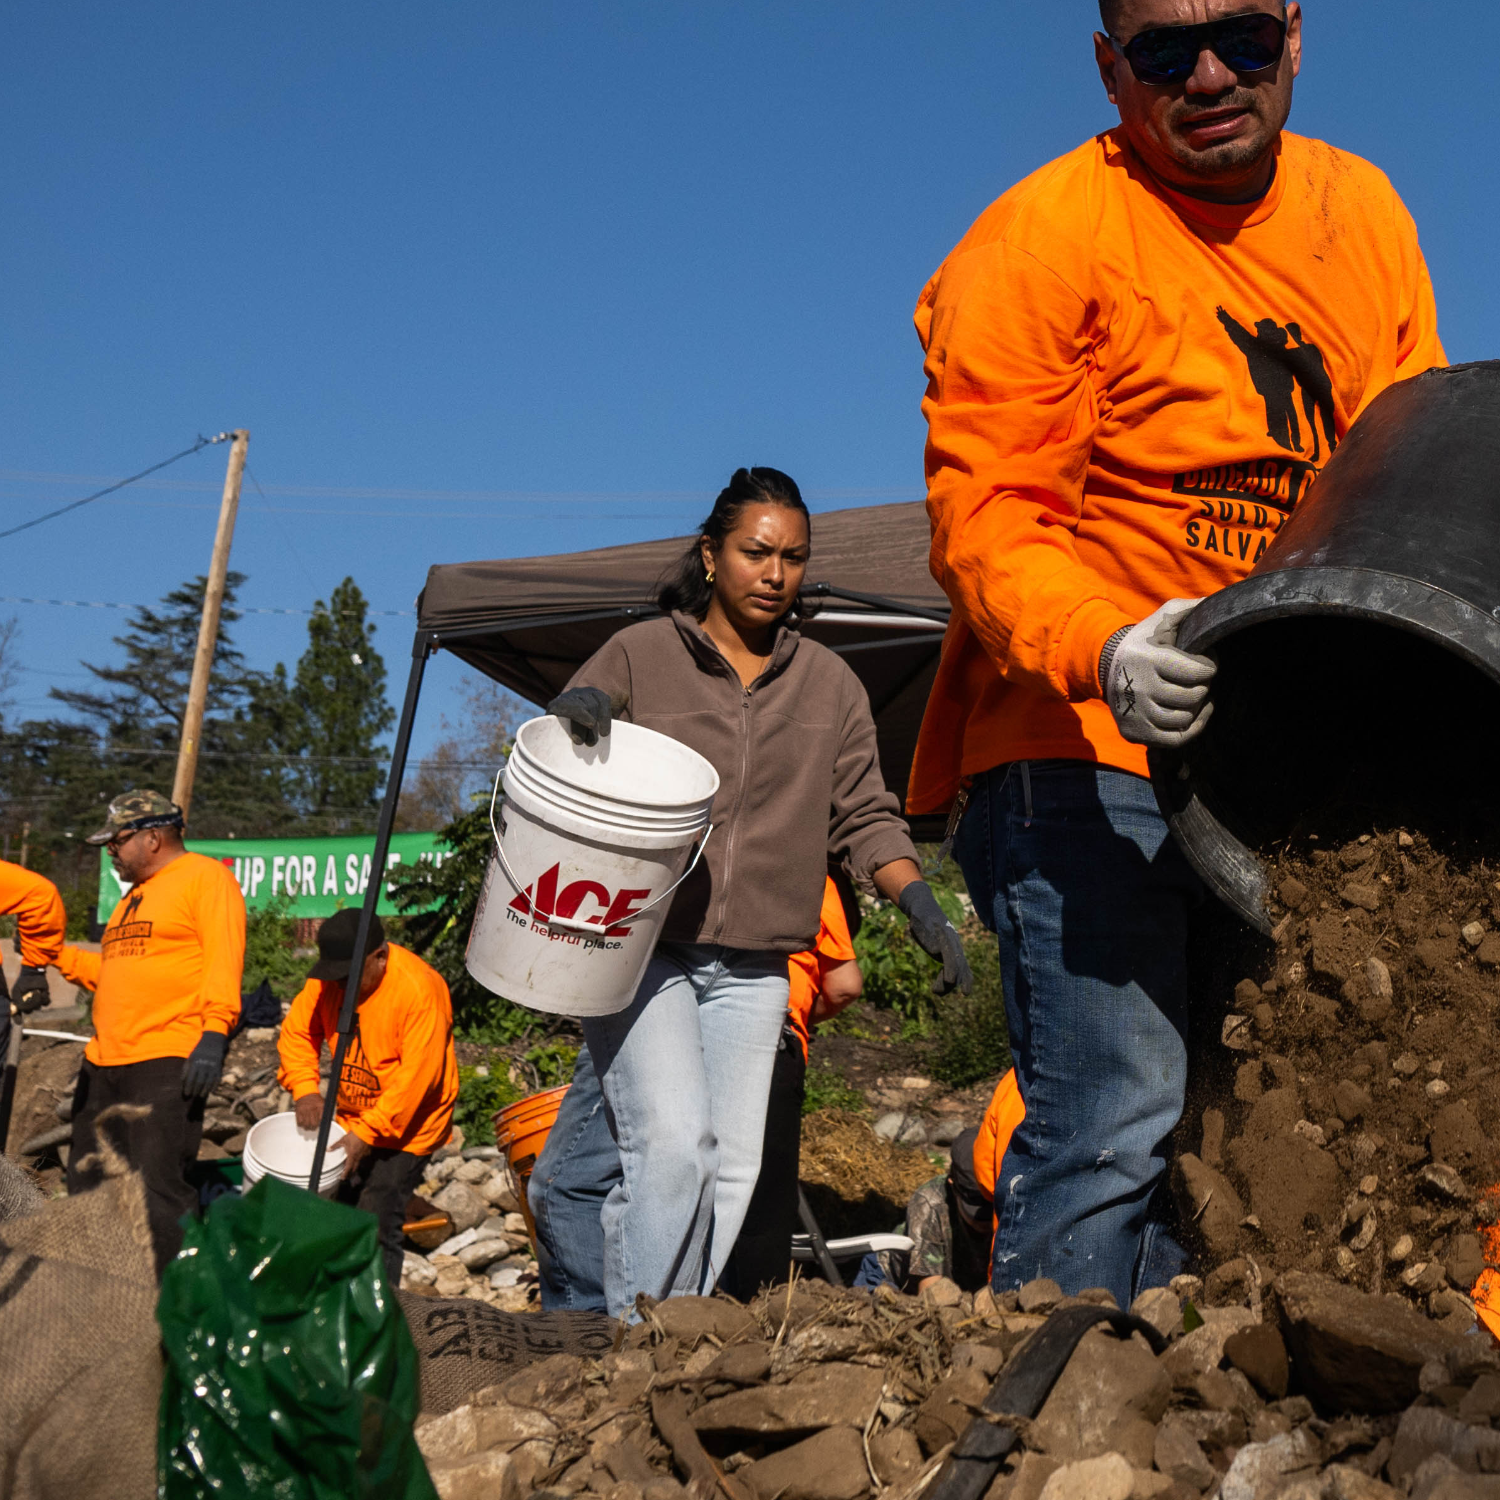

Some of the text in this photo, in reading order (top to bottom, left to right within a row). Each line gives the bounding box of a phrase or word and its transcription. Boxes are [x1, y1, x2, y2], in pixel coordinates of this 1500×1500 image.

[1183, 461, 1293, 504] BRIGADA
[1186, 521, 1268, 564] SALVA
[233, 856, 266, 898] UP
[272, 855, 317, 896] FOR
[322, 854, 339, 896] A
[345, 852, 401, 896] SAE
[508, 861, 652, 937] ACE
[506, 907, 623, 950] The helpful place.
